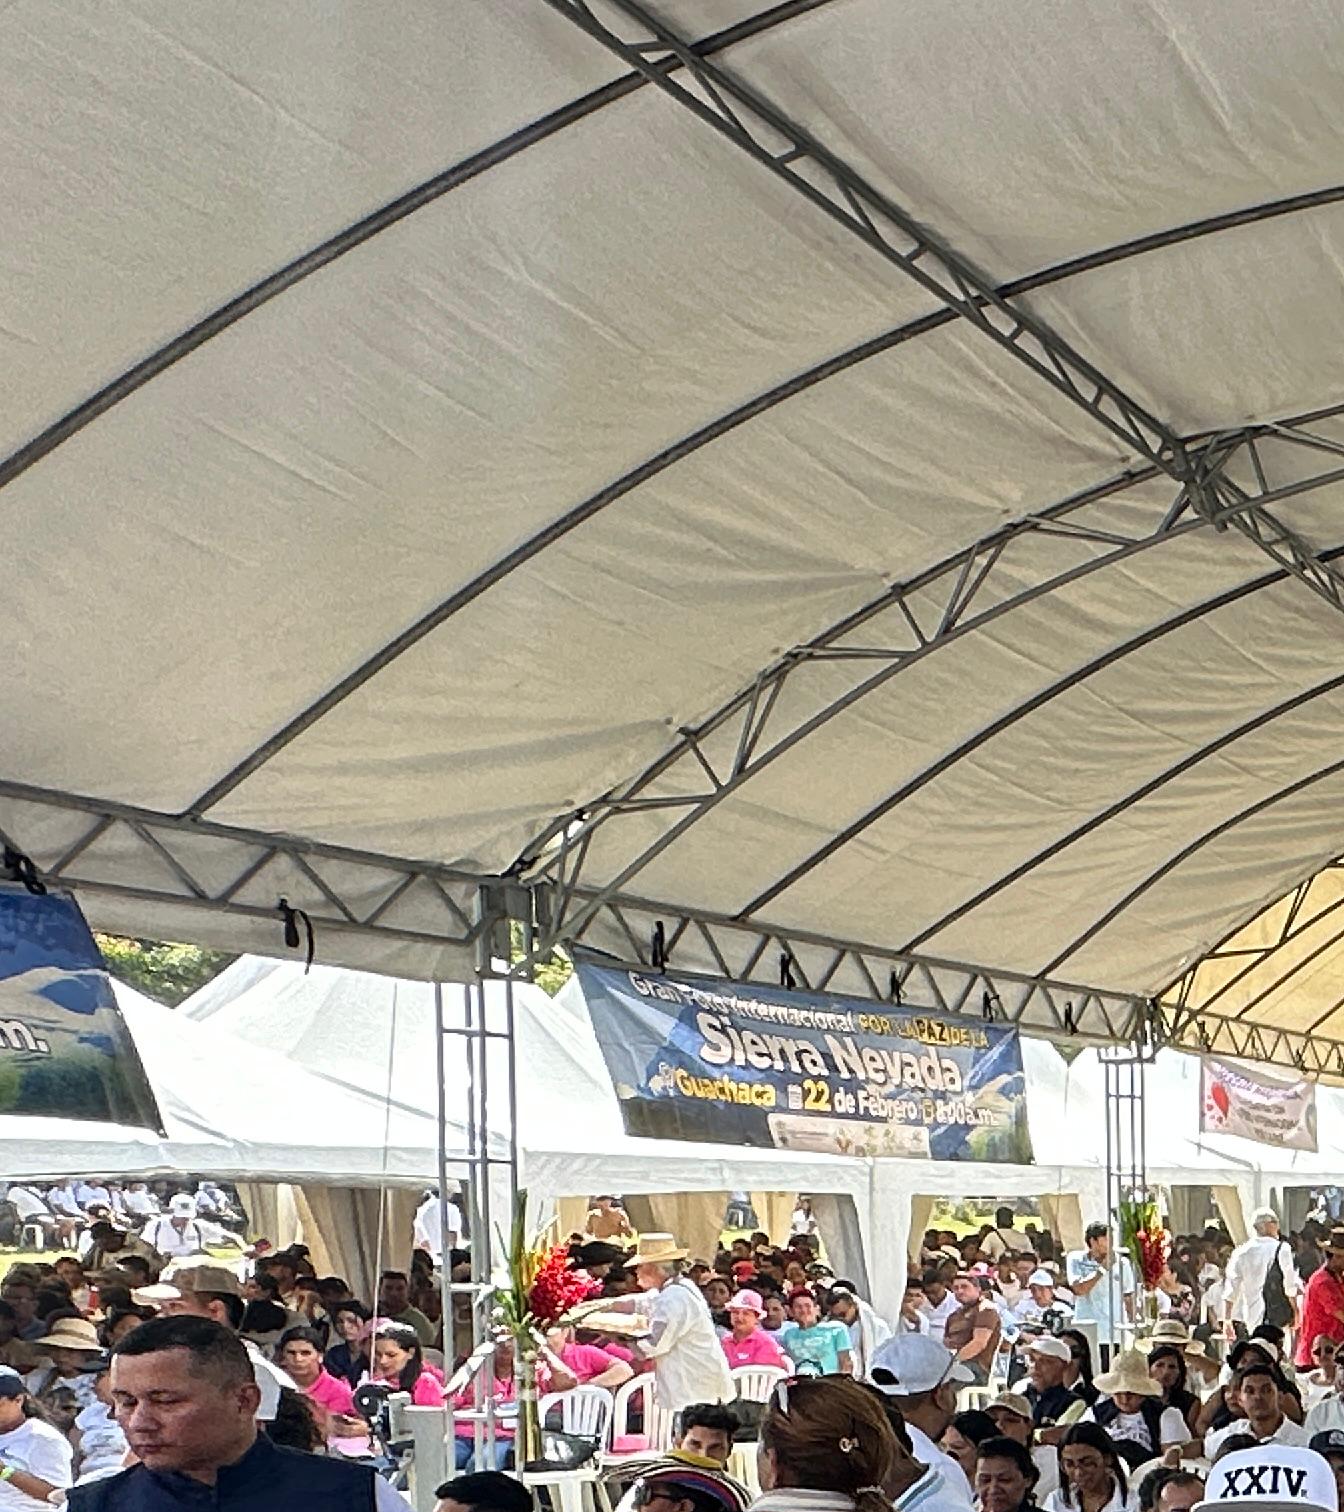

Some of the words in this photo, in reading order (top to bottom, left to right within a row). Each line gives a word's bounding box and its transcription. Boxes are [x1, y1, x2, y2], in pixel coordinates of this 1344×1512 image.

[731, 995, 857, 1033] Internacional
[915, 1017, 949, 1043] PAZ
[696, 1012, 829, 1076] Sierra
[823, 1034, 963, 1093] Nevada
[674, 1067, 777, 1107] Guachaca
[803, 1078, 832, 1112] 22
[834, 1086, 856, 1114] de
[857, 1089, 918, 1124] Febrero
[1220, 1465, 1308, 1499] XXIV
